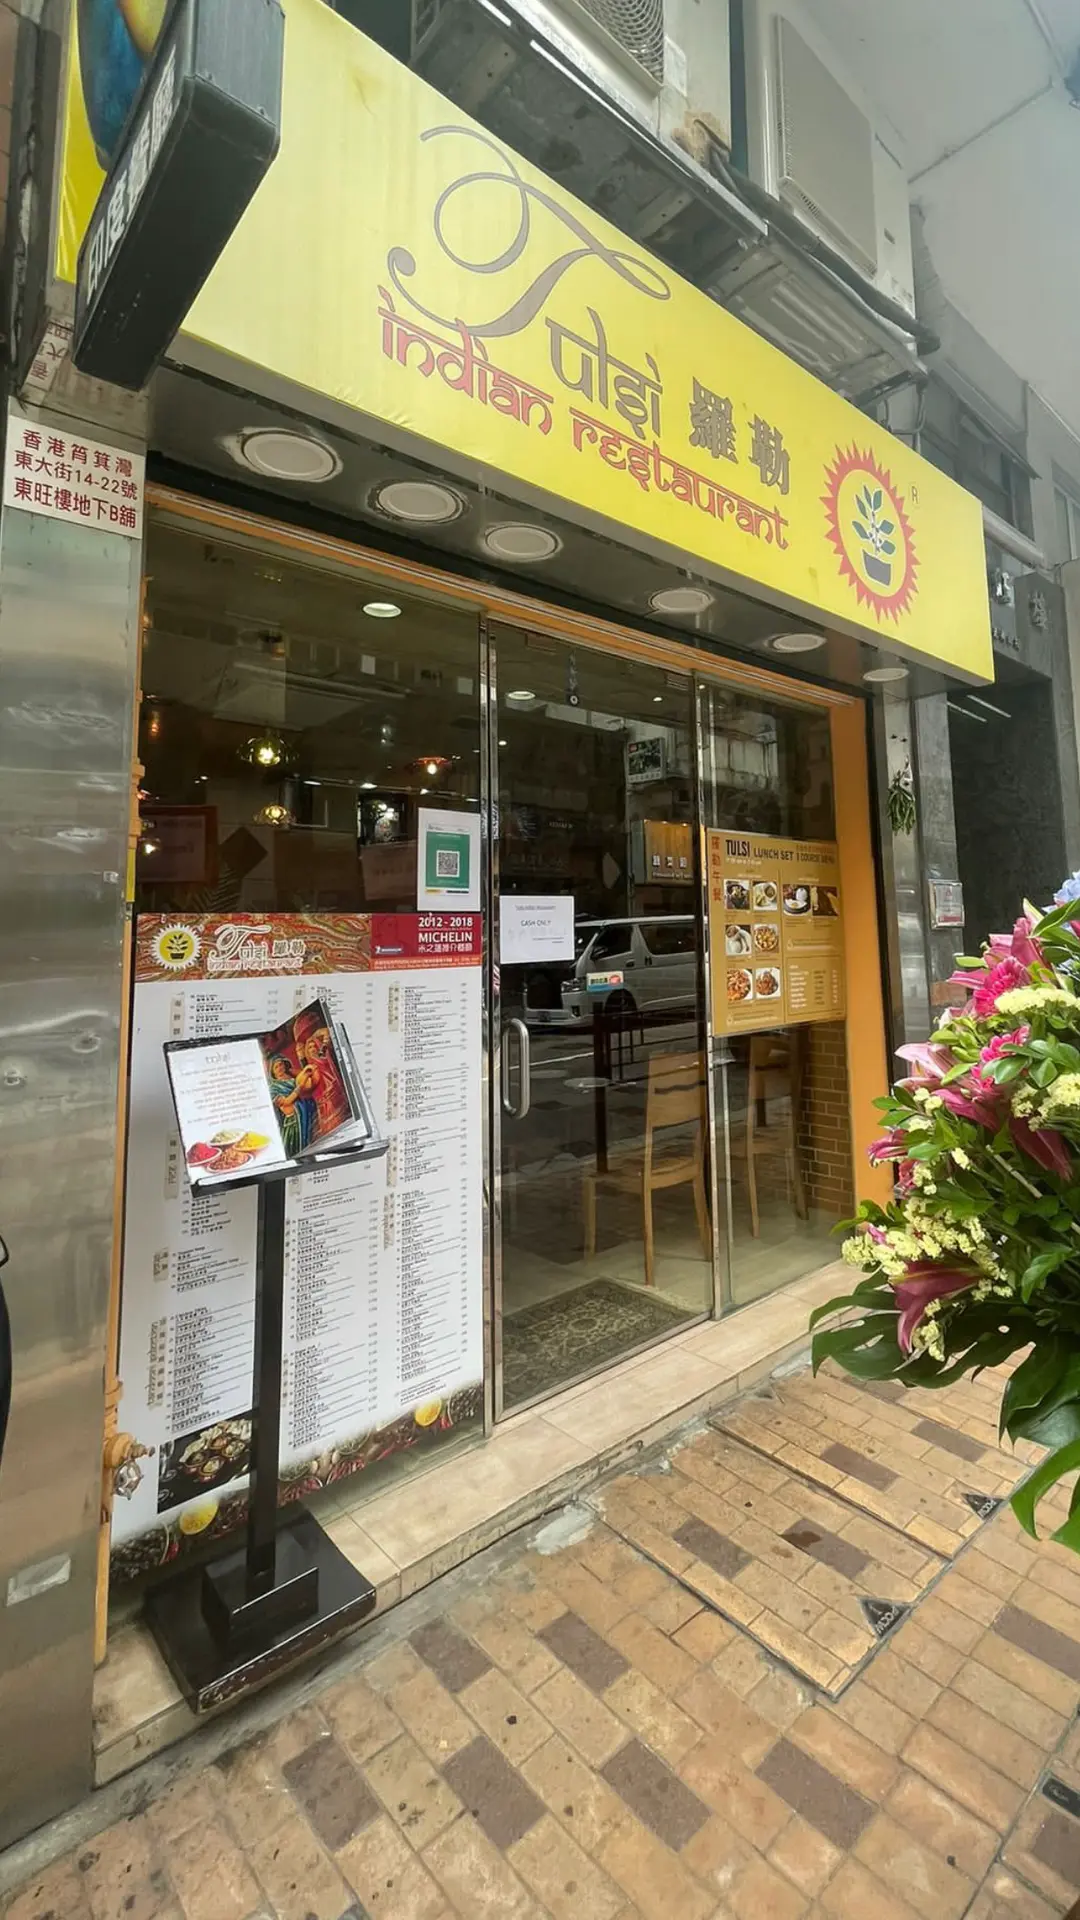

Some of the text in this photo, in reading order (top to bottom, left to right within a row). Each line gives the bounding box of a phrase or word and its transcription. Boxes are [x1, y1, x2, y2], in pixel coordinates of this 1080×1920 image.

[22, 428, 134, 478] 香港筲箕灣
[688, 375, 791, 496] 羅勒
[13, 449, 139, 501] 東大街14-22號
[568, 406, 789, 551] restaurant
[725, 839, 750, 856] TULSI
[753, 847, 779, 860] LUNCH
[780, 850, 794, 861] SET
[418, 917, 443, 928] 2012
[450, 916, 473, 927] 2018
[418, 932, 473, 943] MICHELIN
[520, 919, 552, 927] CASH ONLY
